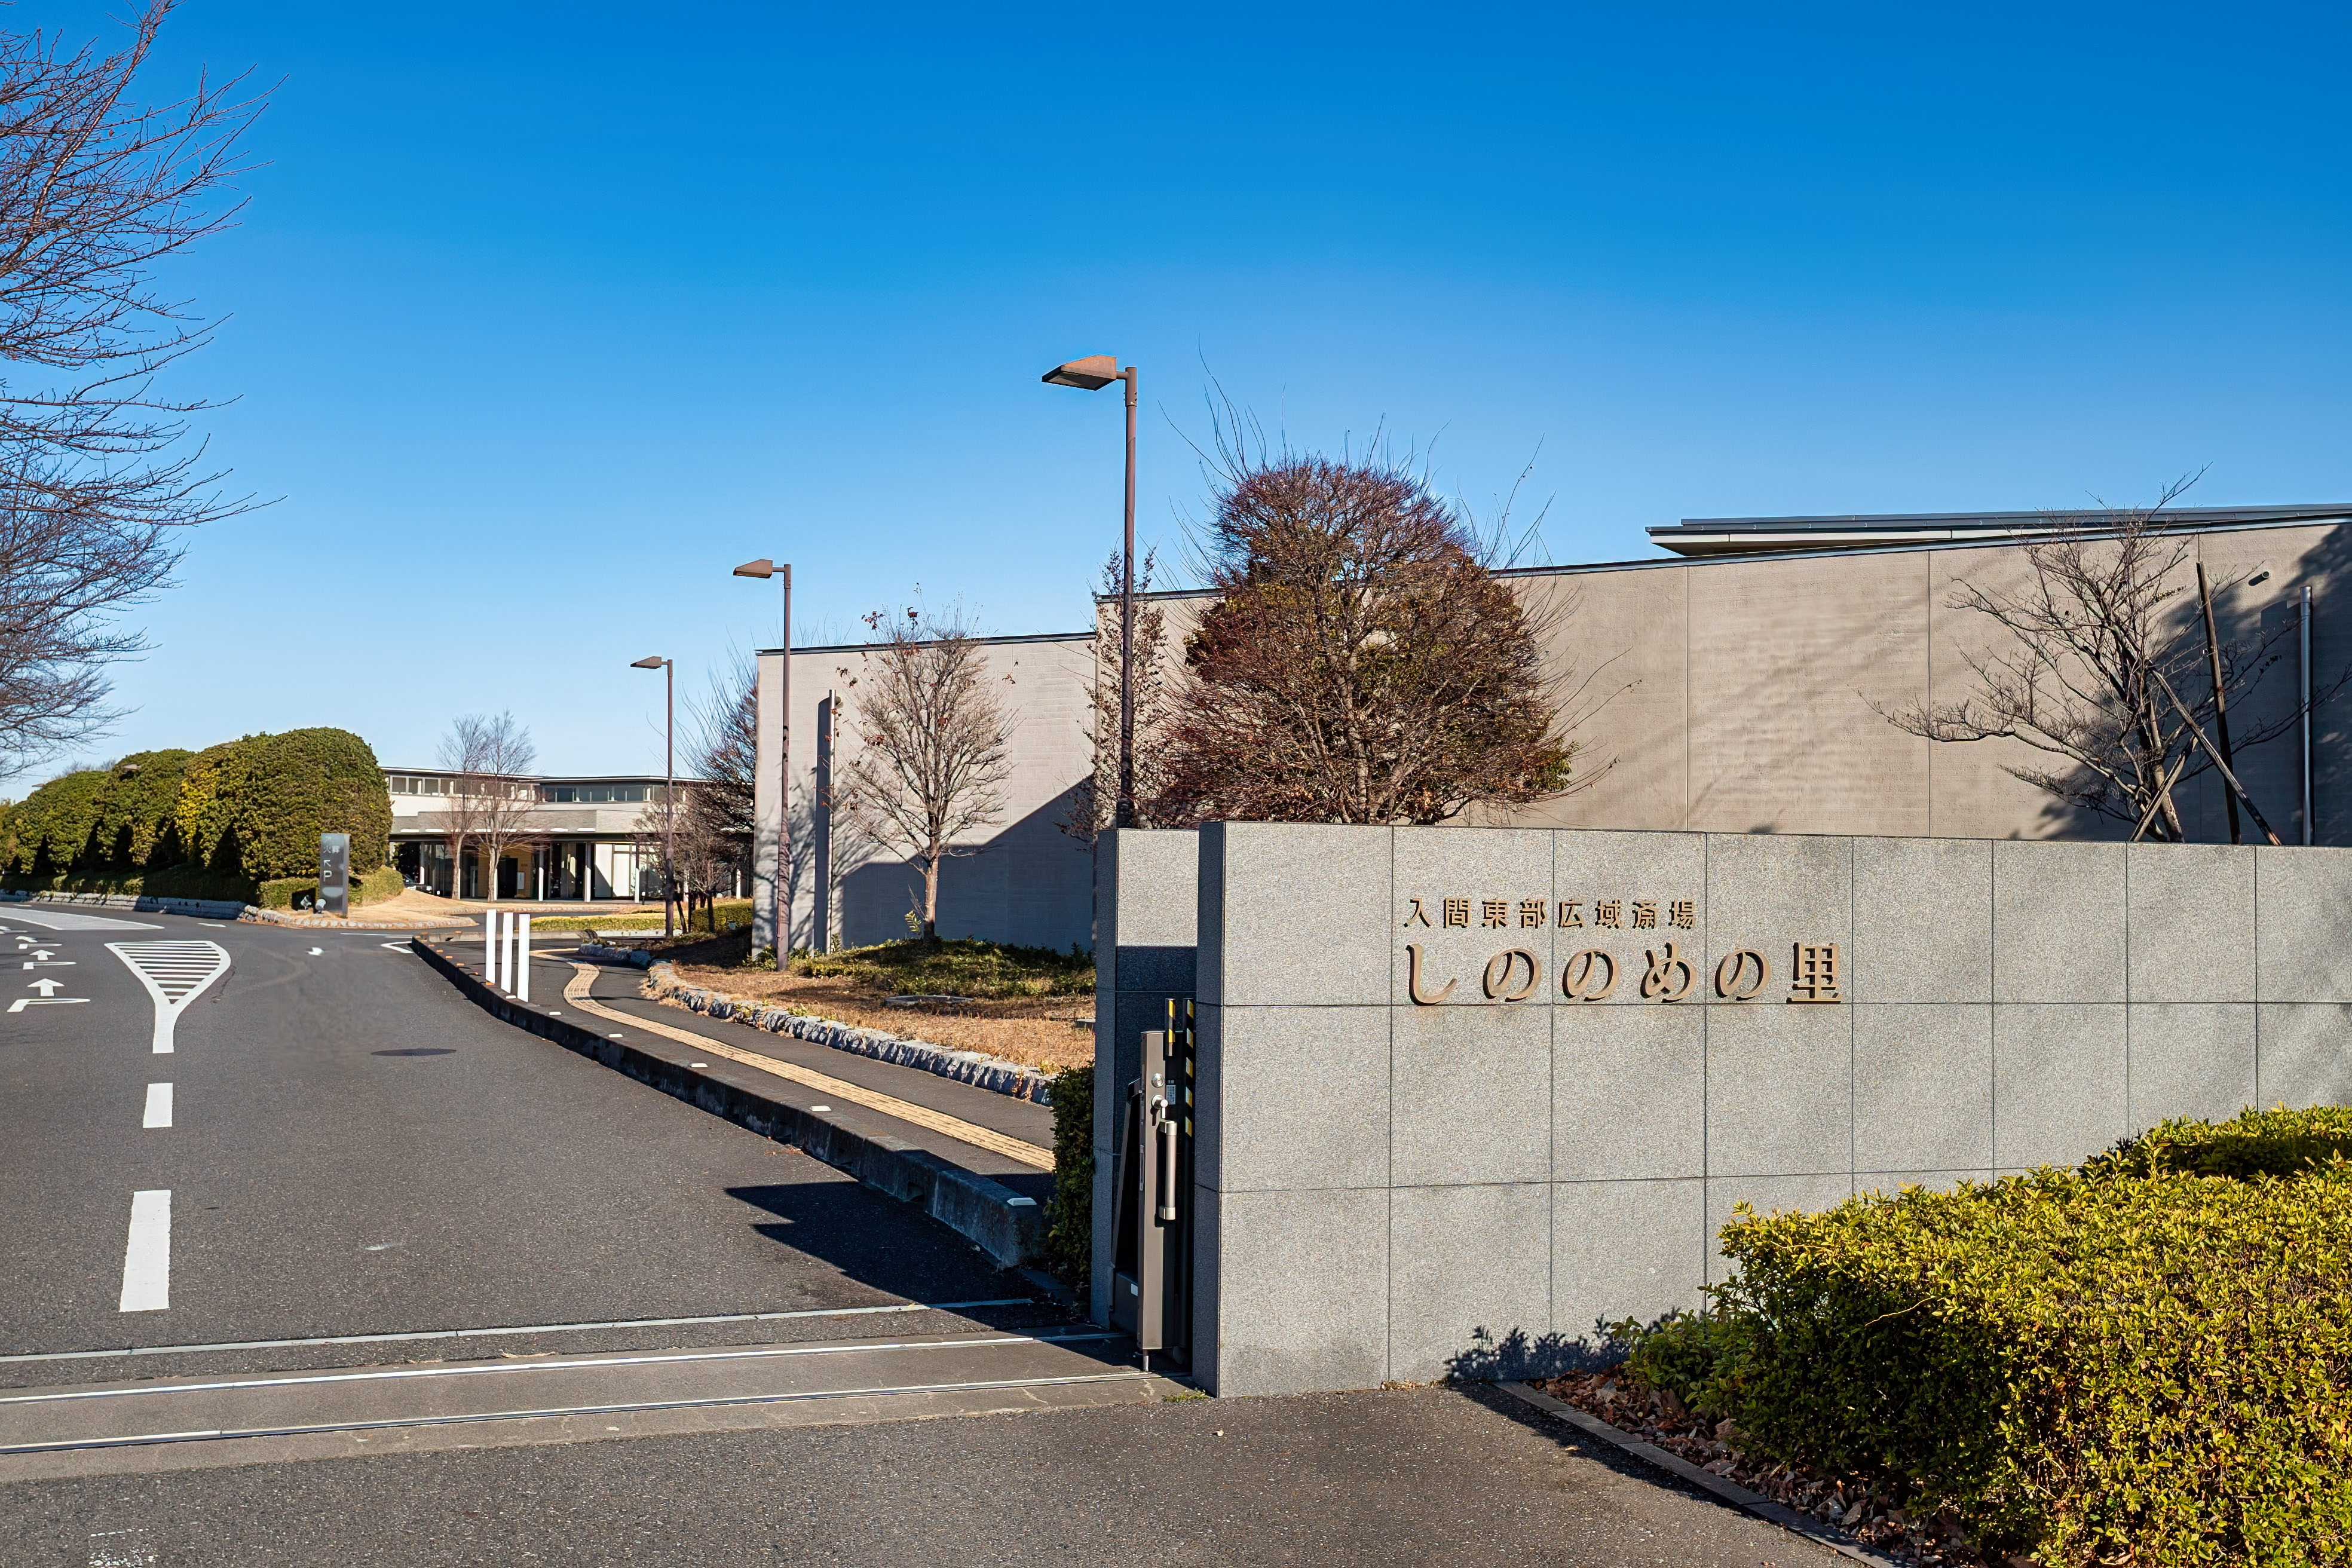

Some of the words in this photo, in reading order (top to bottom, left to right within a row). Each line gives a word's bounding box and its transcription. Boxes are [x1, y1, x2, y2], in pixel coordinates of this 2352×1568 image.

[323, 870, 332, 882] P
[1404, 897, 1696, 929] 入間東部広域斎場
[1405, 942, 1845, 1006] しののめの里
